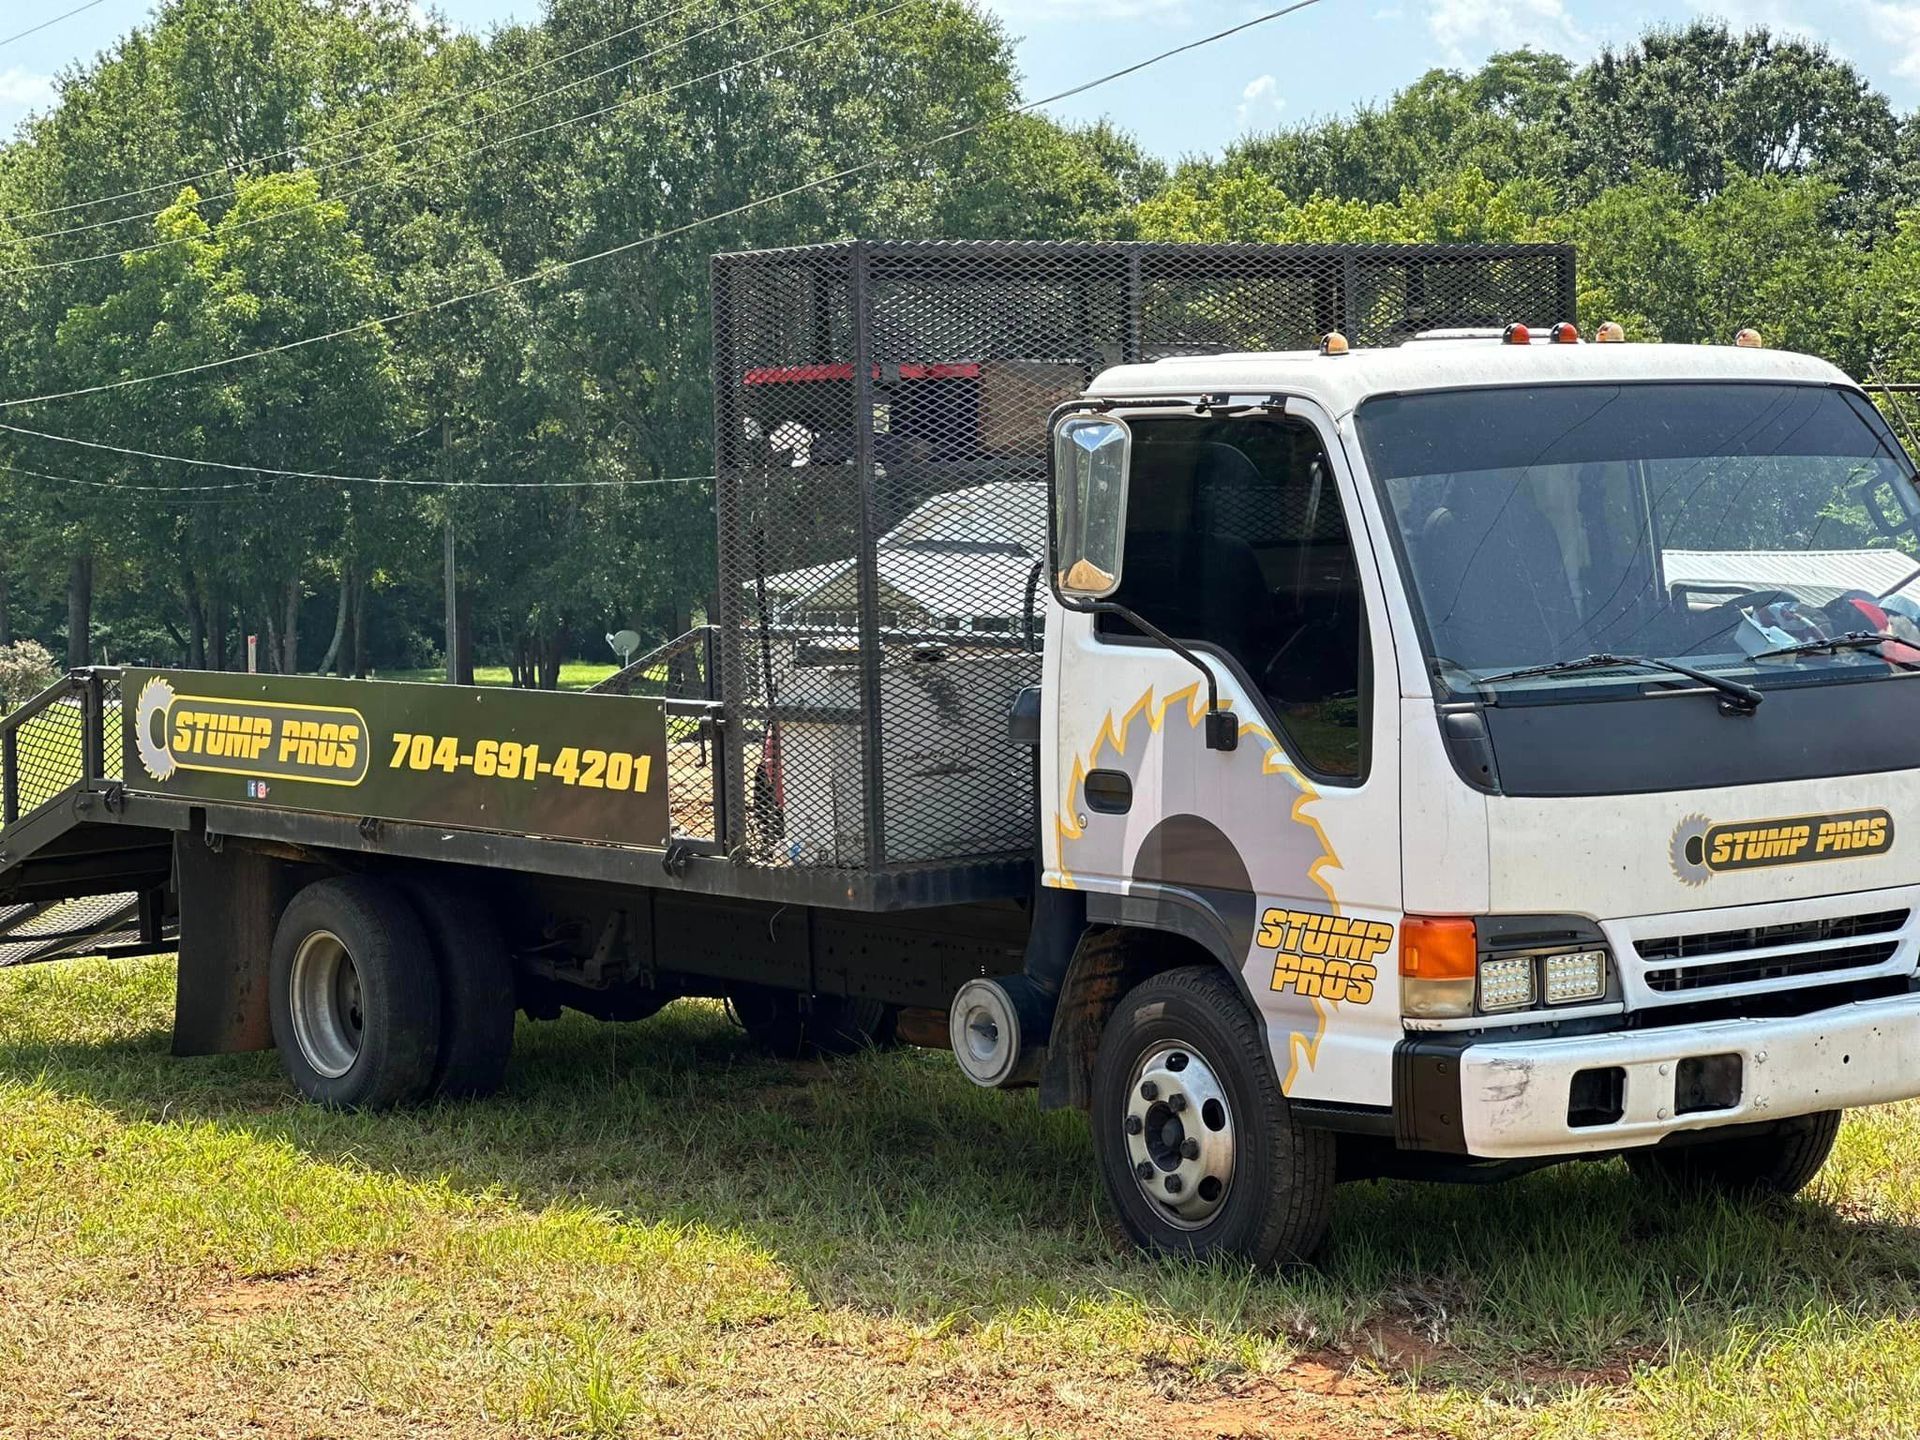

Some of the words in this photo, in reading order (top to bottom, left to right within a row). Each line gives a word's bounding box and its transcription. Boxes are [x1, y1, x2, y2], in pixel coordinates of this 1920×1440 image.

[173, 711, 271, 759] STUMP
[279, 719, 360, 768] PROS
[390, 733, 651, 793] 704-691-4201
[1711, 826, 1810, 863] STUMP
[1815, 817, 1887, 853] PROS
[1256, 907, 1394, 962] STUMP
[1270, 951, 1377, 1004] PROS
